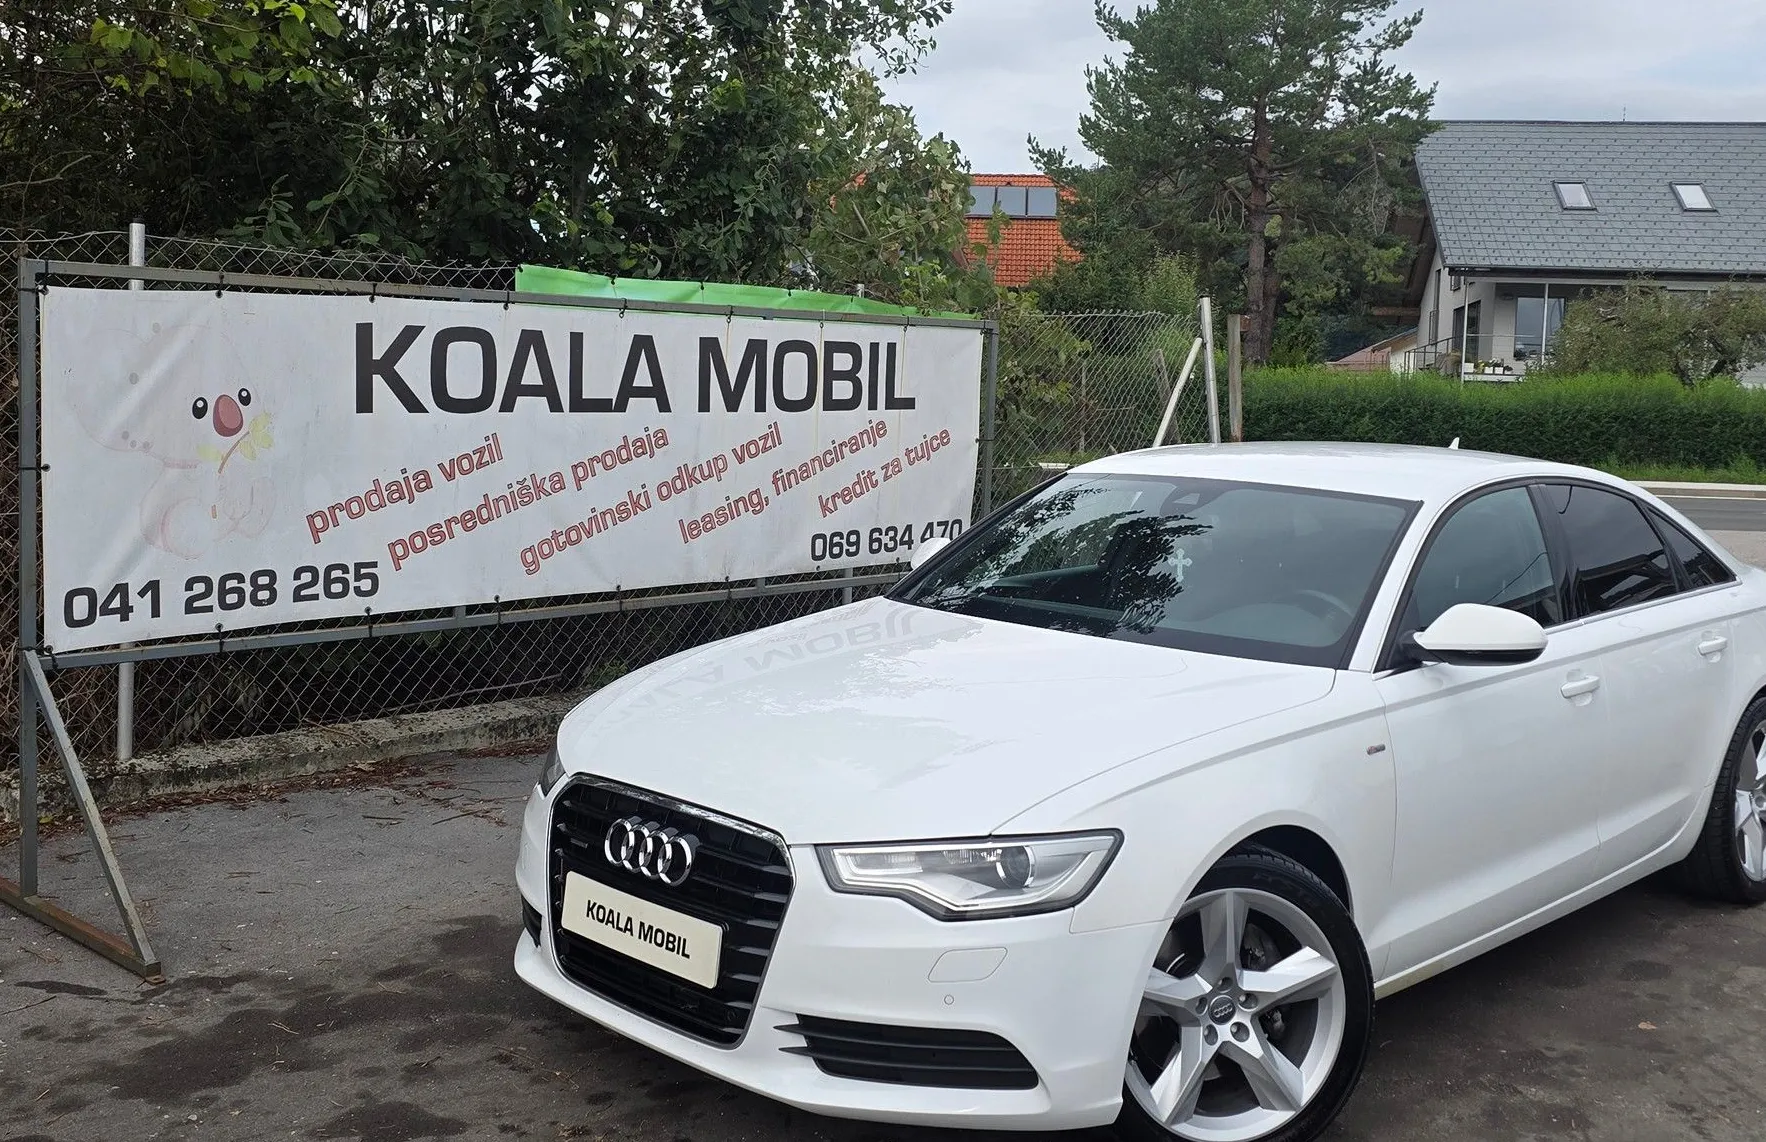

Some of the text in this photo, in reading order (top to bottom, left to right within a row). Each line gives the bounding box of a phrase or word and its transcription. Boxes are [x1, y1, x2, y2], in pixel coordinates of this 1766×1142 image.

[356, 322, 915, 413] KOALA MOBIL
[306, 433, 503, 544] prodaja vozil
[388, 427, 669, 571] posredniška prodaja
[520, 420, 782, 575] gotovinski odkup vozil
[679, 419, 887, 544] leasing, financiranje
[818, 429, 951, 518] kredit za tujce
[811, 518, 962, 561] 069 634 470
[64, 561, 379, 628] 041 268 265
[586, 900, 690, 959] KOALA MOBIL
